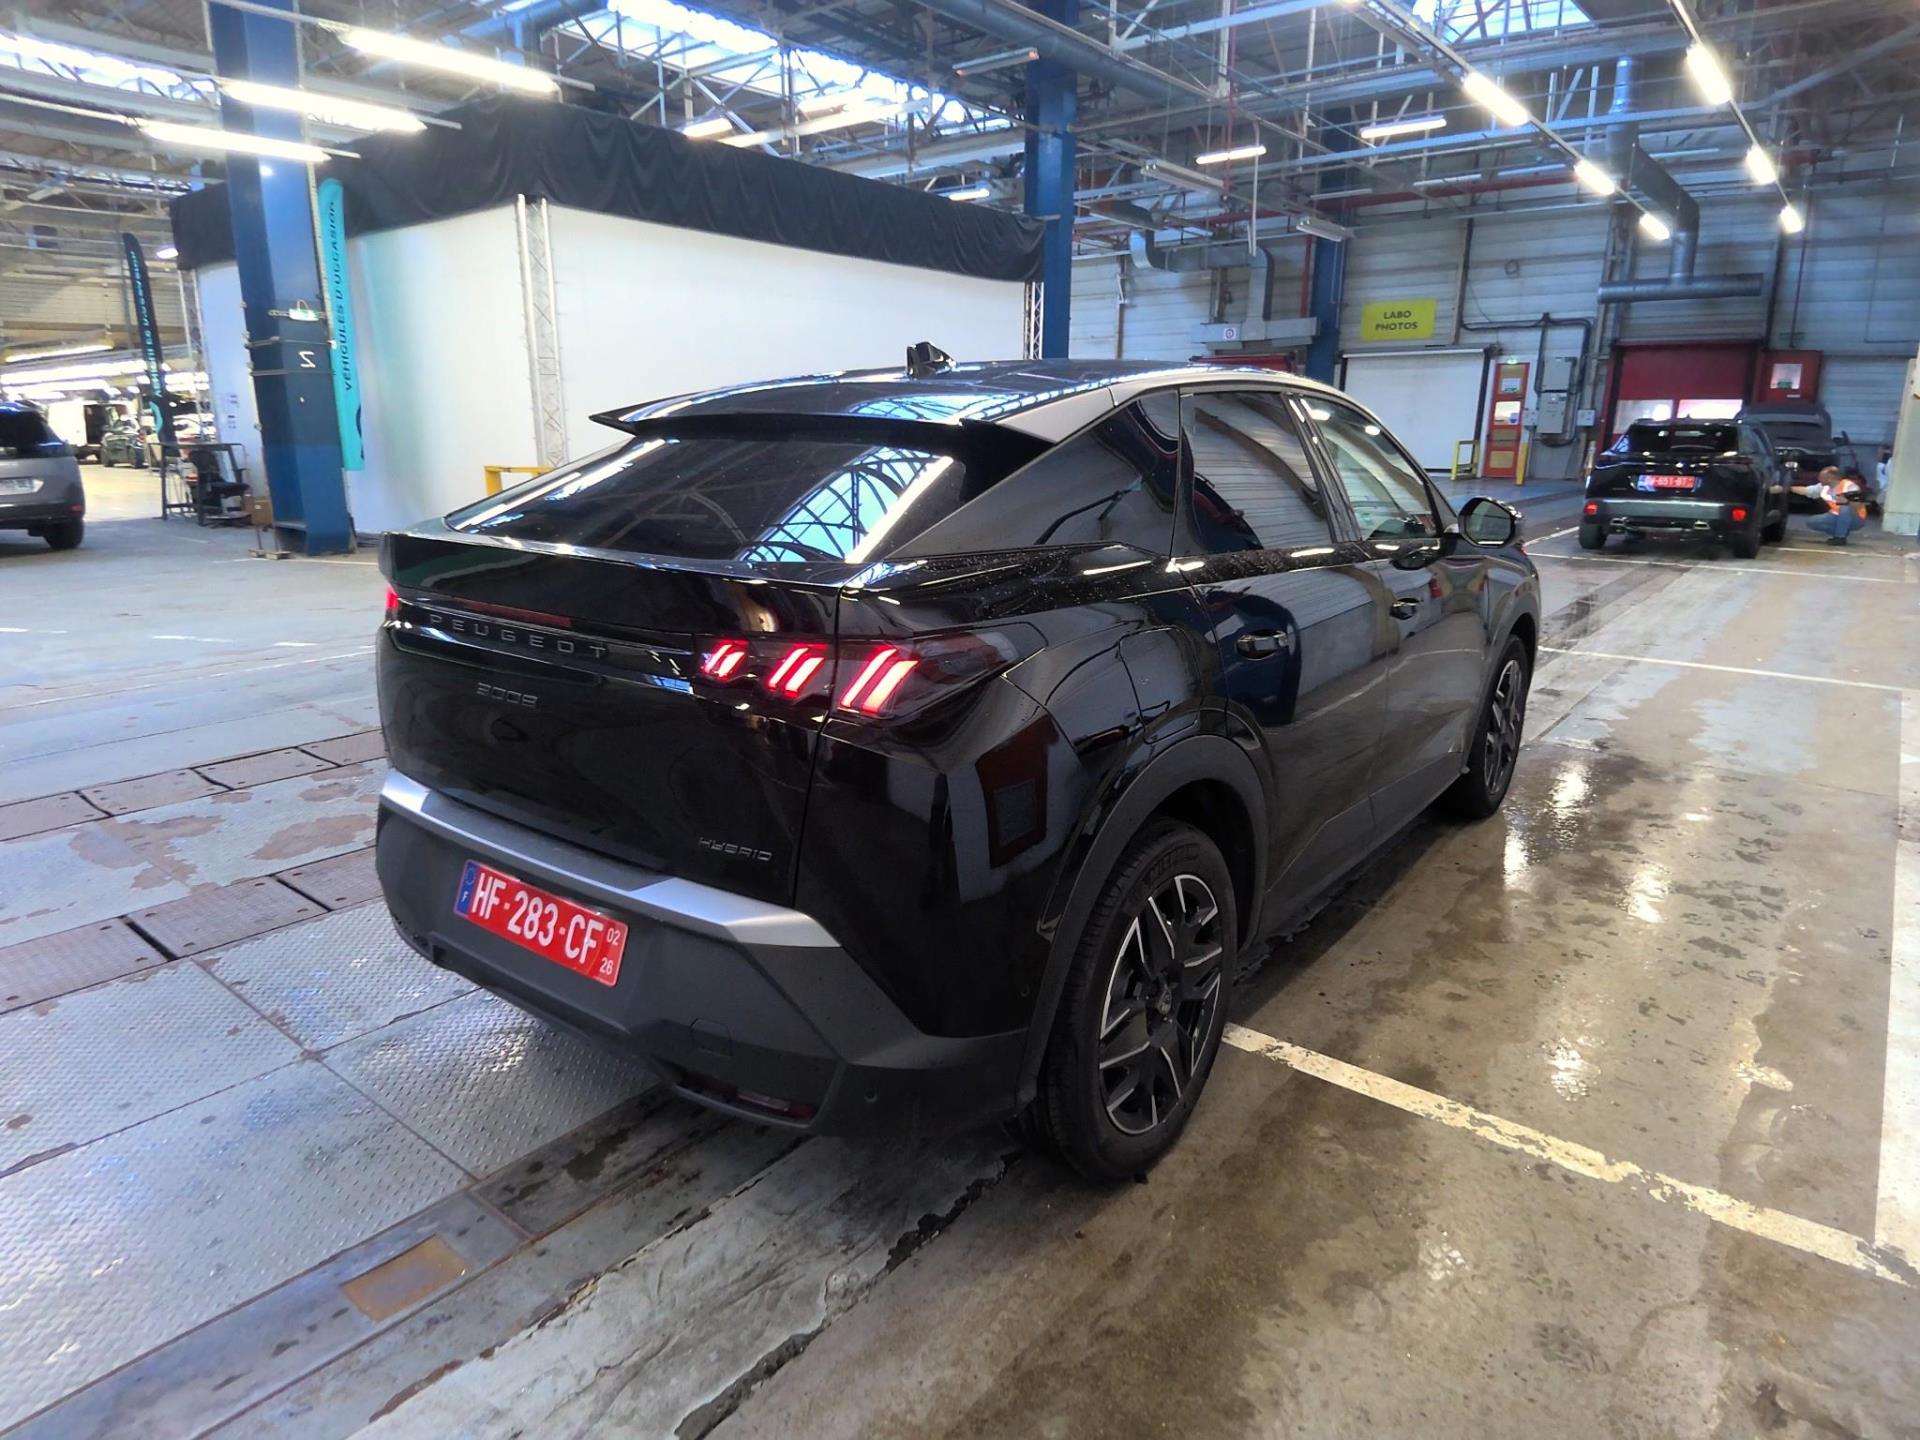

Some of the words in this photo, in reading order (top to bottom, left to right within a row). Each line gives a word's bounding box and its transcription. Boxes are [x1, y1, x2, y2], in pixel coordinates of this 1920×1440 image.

[1383, 310, 1412, 320] LABO
[1375, 321, 1418, 332] PHOTOS
[429, 613, 606, 659] PEUGEOT
[698, 836, 772, 861] HYBRID
[606, 927, 622, 946] 02
